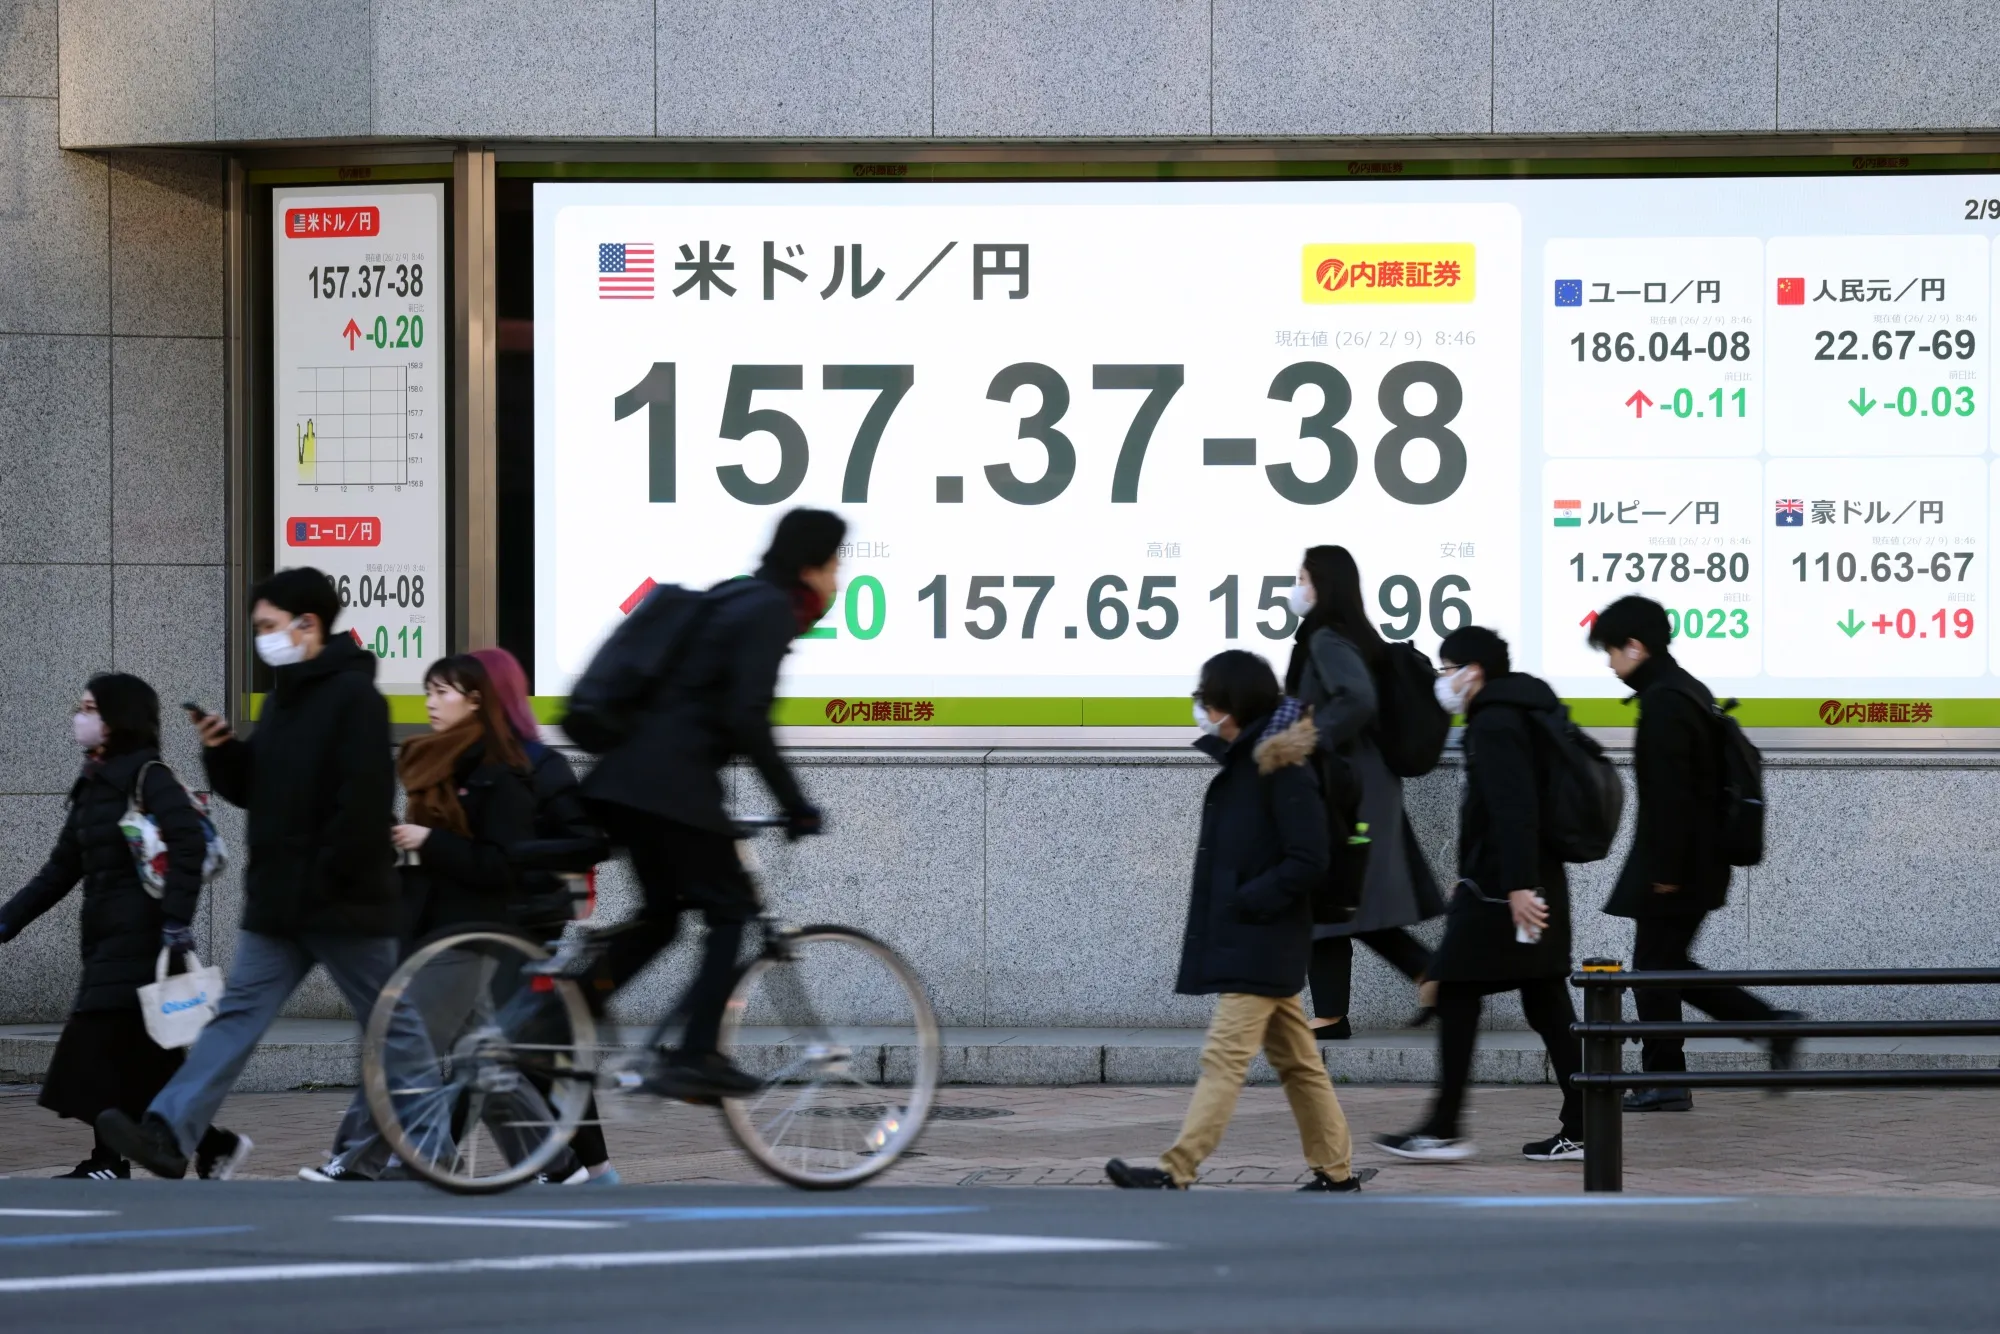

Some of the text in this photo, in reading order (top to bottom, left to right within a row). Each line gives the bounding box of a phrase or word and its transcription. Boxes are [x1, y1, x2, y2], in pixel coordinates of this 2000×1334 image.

[1965, 199, 2000, 220] 2/9
[309, 264, 423, 299] 157.37-38
[1350, 260, 1461, 288] 内藤証券
[366, 315, 423, 349] -0.20
[1275, 331, 1328, 347] 現在値
[1436, 331, 1475, 345] 8:46
[1571, 331, 1750, 362] 186.04-08
[1815, 330, 1975, 360] 22.67-69
[1725, 372, 1751, 381] 前日比
[1949, 370, 1976, 380] 前日比
[1660, 388, 1745, 418] -0.11
[1884, 386, 1975, 417] -0.03
[615, 361, 1467, 507] 157.37-38
[838, 541, 890, 558] 前日比
[1147, 542, 1180, 558] 高値
[1441, 542, 1475, 558] 安値
[1570, 552, 1749, 582] 1.7378-80
[1793, 552, 1974, 582] 110.63-67
[326, 575, 424, 608] 6.04-08
[918, 575, 1179, 640] 157.65
[1209, 574, 1473, 640] 1596
[1872, 608, 1974, 638] +0.19
[367, 625, 422, 658] -0.11
[850, 701, 935, 723] 内藤証券
[1845, 702, 1934, 724] 内藤証券
